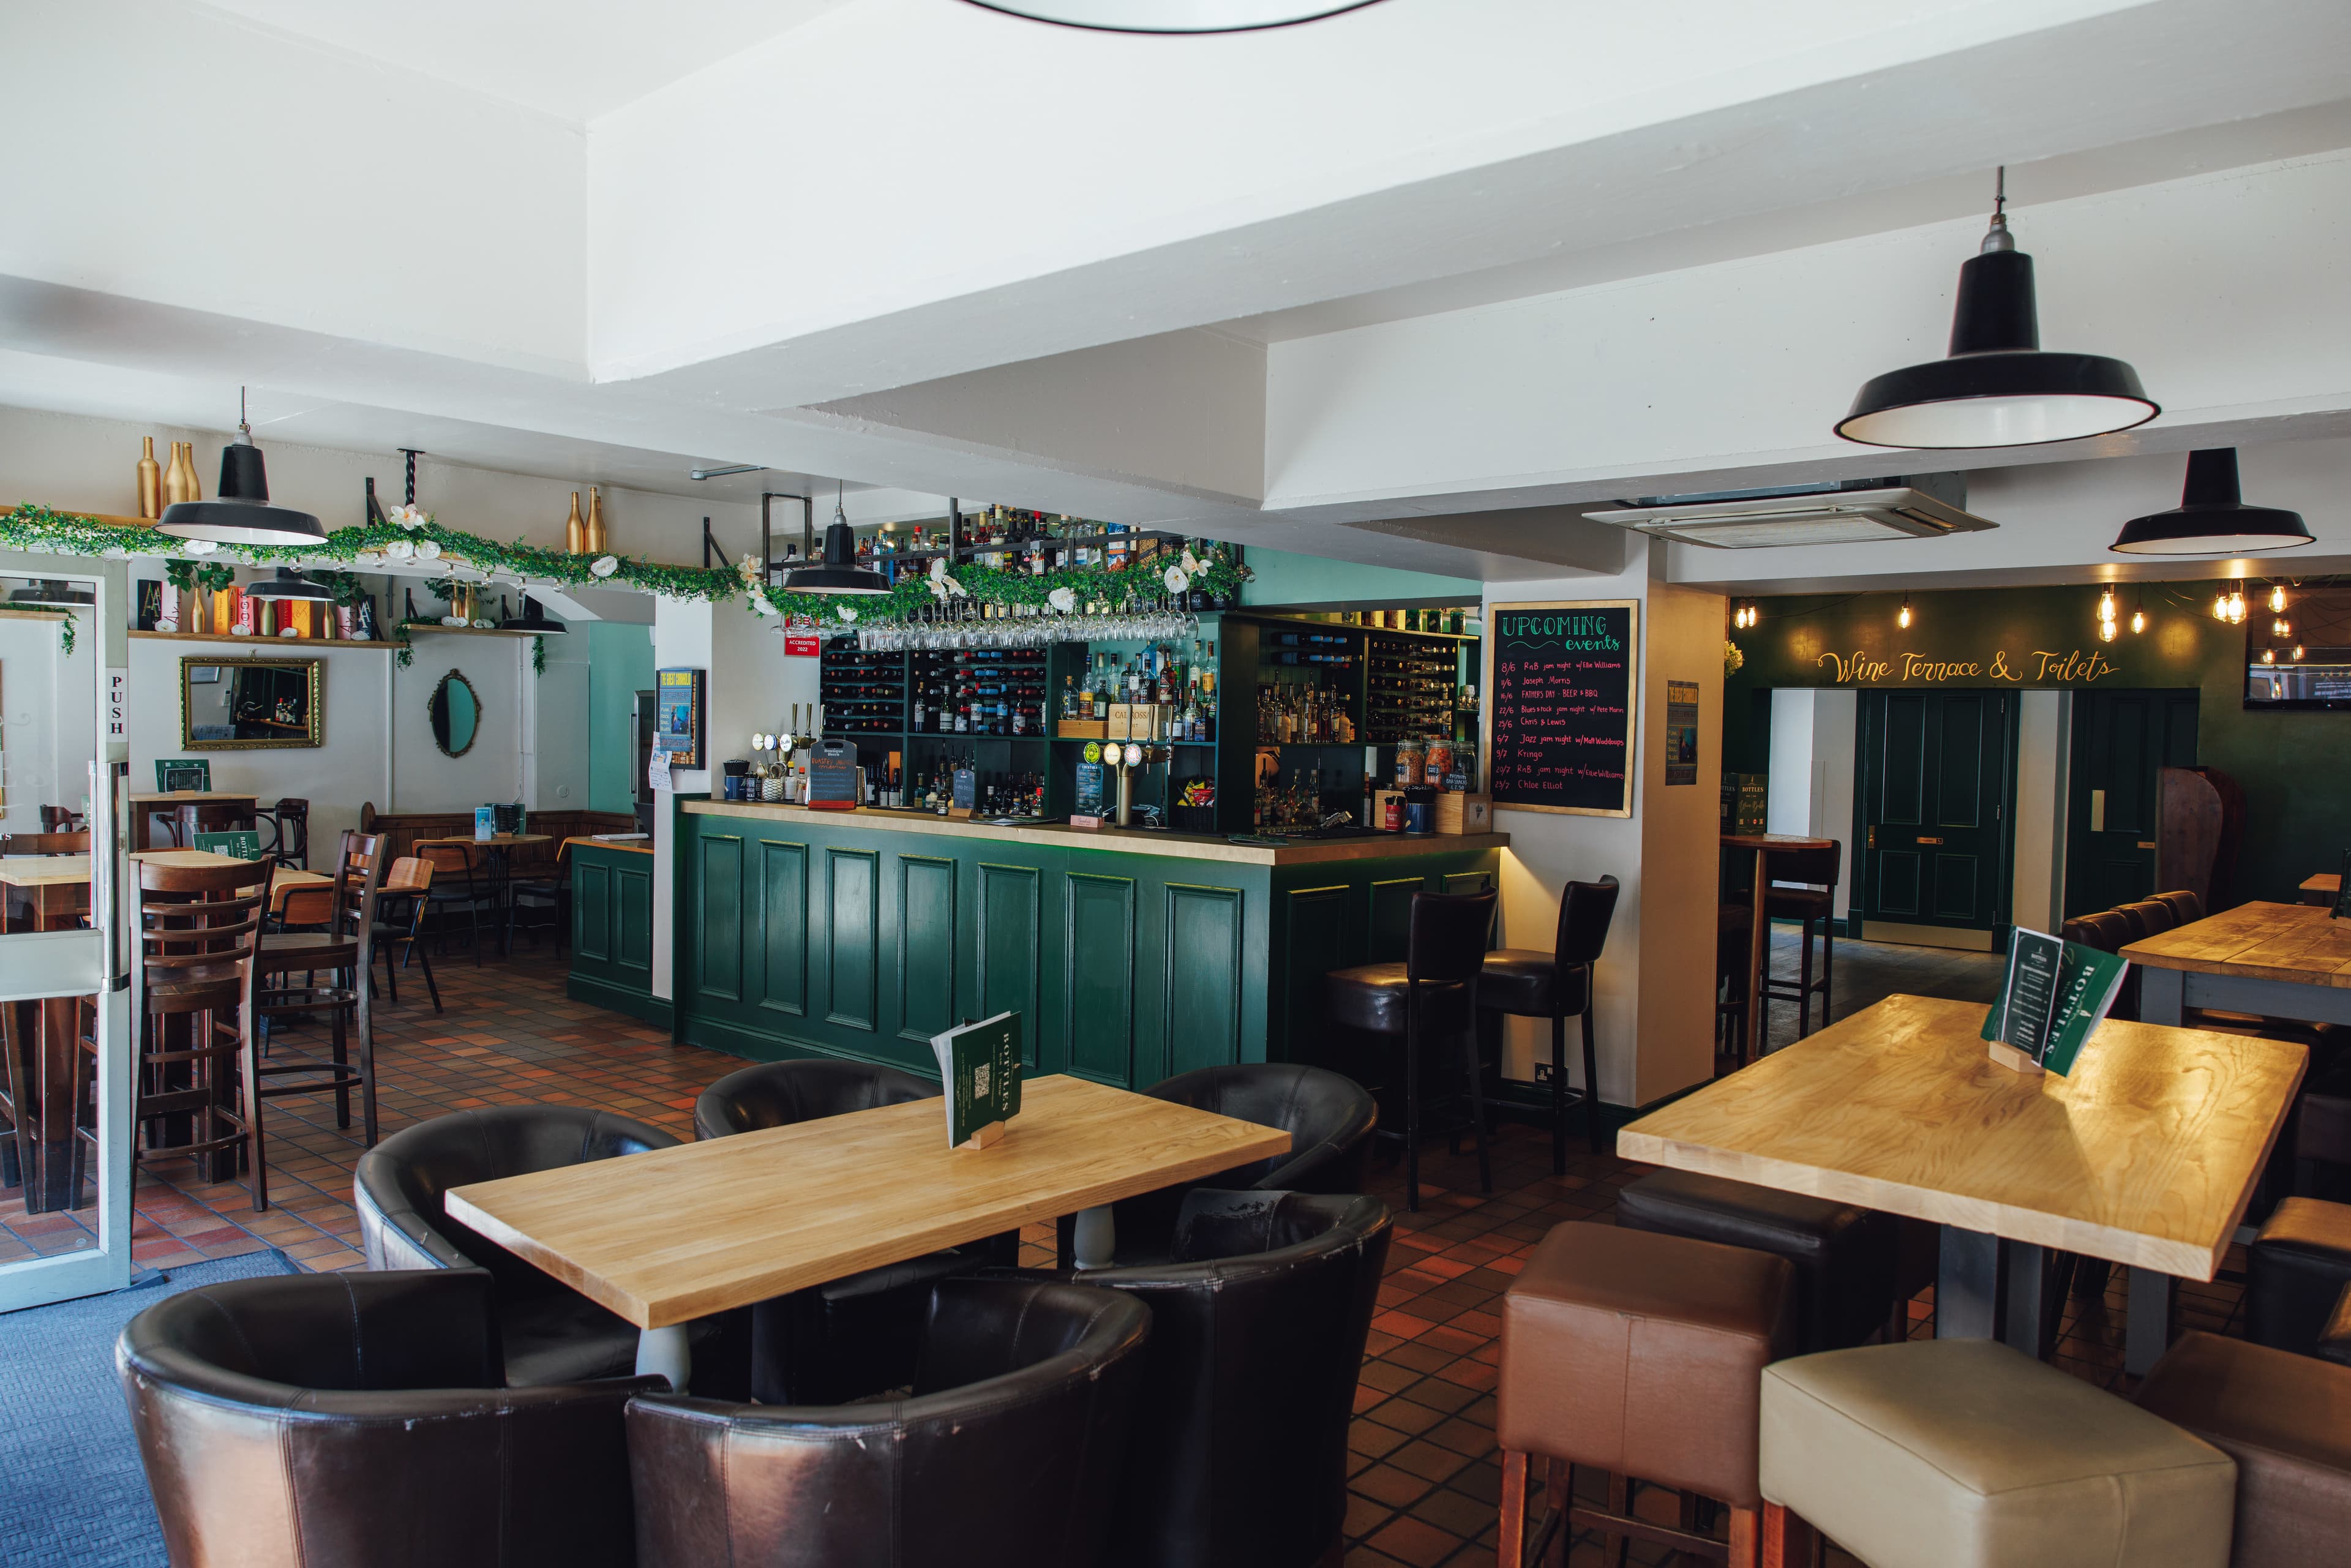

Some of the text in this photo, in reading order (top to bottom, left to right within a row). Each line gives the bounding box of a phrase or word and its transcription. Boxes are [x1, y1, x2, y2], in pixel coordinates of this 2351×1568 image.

[1502, 616, 1607, 636] UPCOMING
[1565, 634, 1621, 651] events
[1501, 661, 1516, 676] 8/6
[1524, 662, 1539, 671] RnB
[1543, 662, 1554, 671] jam
[1557, 662, 1572, 671] night
[1810, 650, 2121, 682] Wine Terrace & Toilets
[1501, 676, 1571, 689] 11/6 Joseph Morris
[1501, 692, 1513, 703] 16/6
[1522, 690, 1543, 699] FATHERS
[110, 676, 124, 734] PUSH
[1499, 705, 1514, 716] 22/6
[1556, 706, 1568, 715] jam
[1570, 706, 1586, 715] night
[1498, 720, 1513, 730] 25/6
[1521, 717, 1538, 726] Chris
[1497, 733, 1509, 745] 6/7
[1520, 734, 1536, 744] Jazz
[1540, 735, 1553, 745] jam
[1555, 735, 1572, 745] night
[1496, 748, 1543, 761] 9/7 Kringo
[1496, 765, 1511, 776] 20/7
[1517, 765, 1532, 773] RnB
[1537, 767, 1551, 776] jam
[1554, 766, 1573, 776] night
[1518, 779, 1539, 789] Chloe
[1543, 781, 1563, 789] Elliot
[2045, 966, 2094, 1054] BOTTLES
